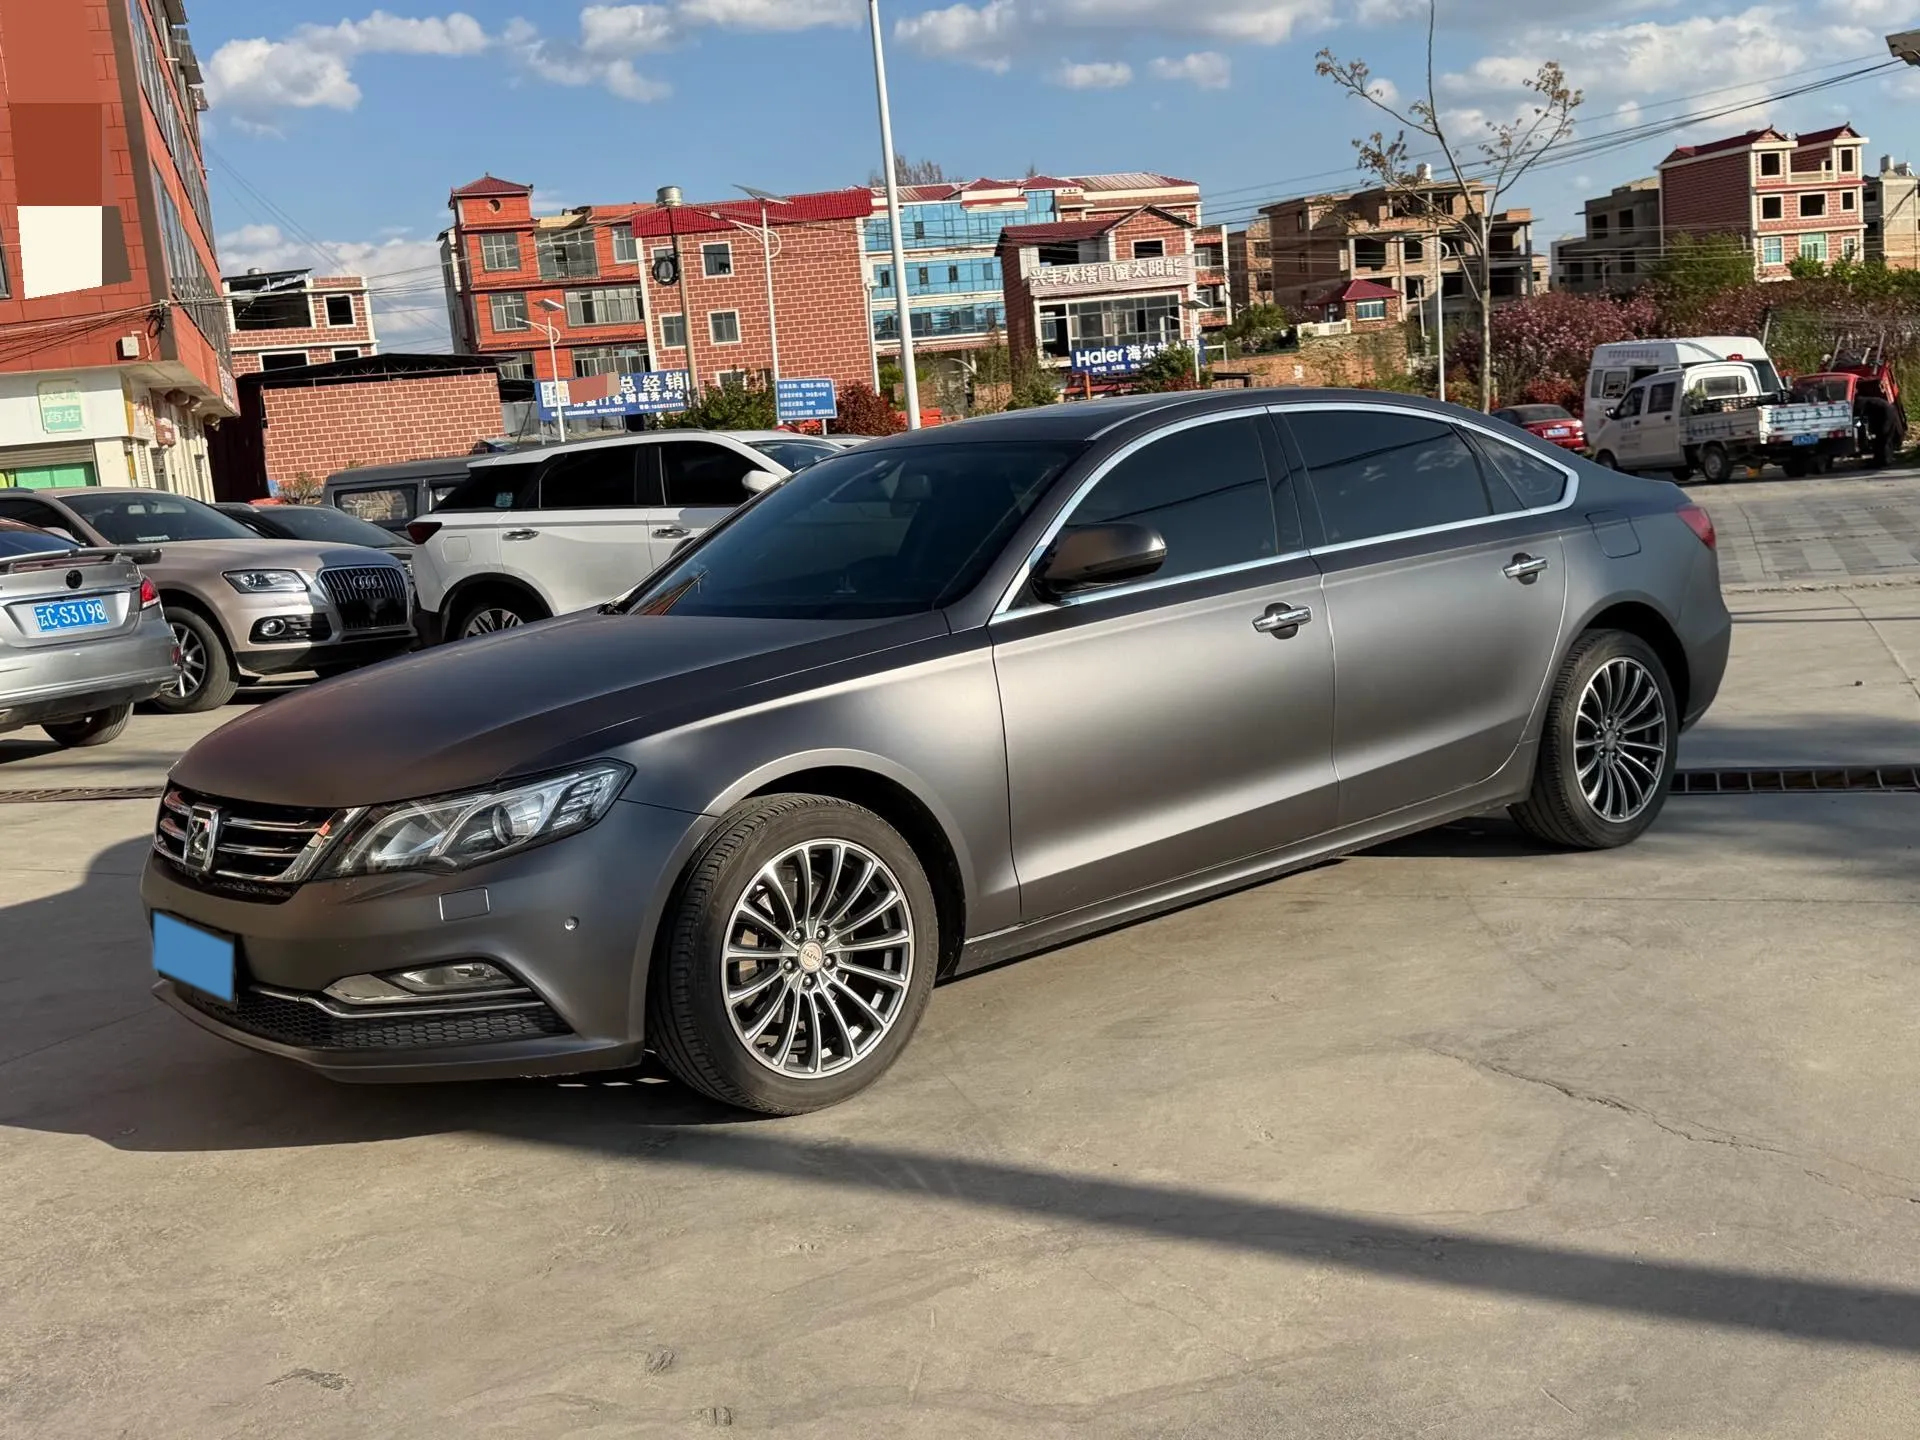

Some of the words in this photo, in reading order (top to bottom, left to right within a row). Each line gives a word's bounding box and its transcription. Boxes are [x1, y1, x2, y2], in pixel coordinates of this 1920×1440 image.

[1075, 347, 1125, 367] Haier
[620, 372, 684, 394] 总经销
